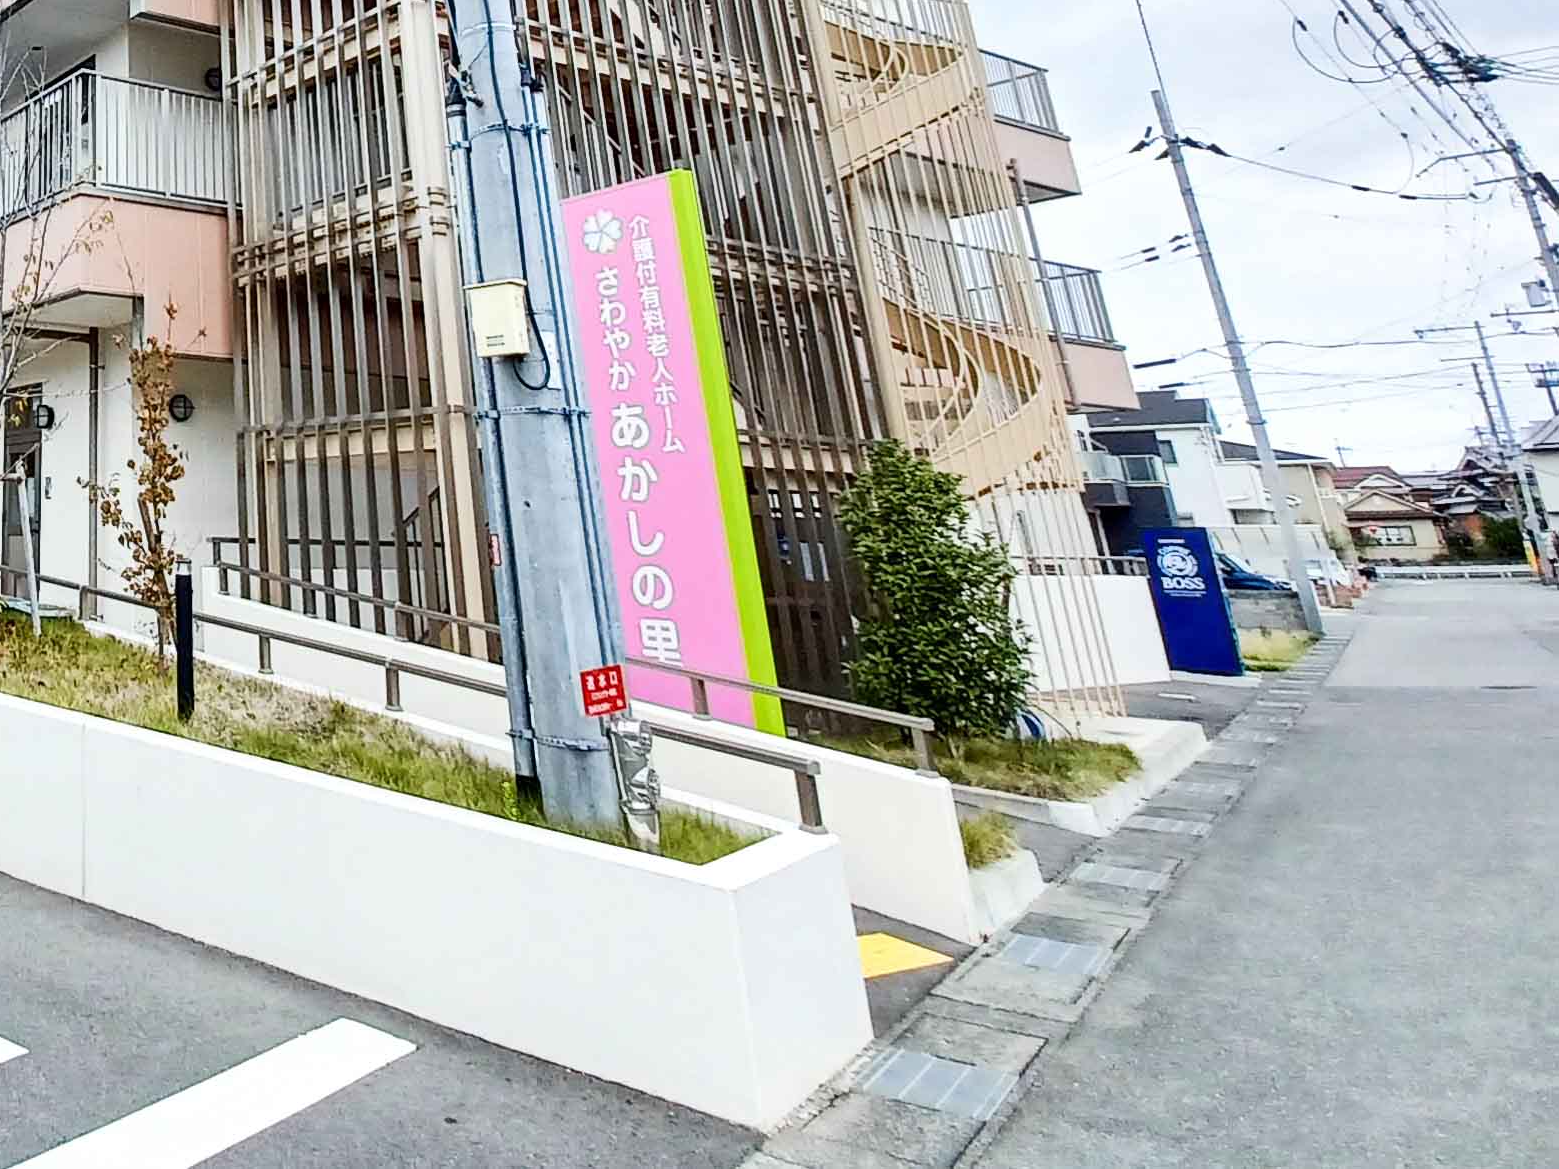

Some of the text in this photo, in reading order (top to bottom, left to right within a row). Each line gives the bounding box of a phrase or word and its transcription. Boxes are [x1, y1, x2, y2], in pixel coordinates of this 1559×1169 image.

[628, 215, 685, 453] 介護付有料老人ホーム
[1161, 577, 1205, 589] BOSS
